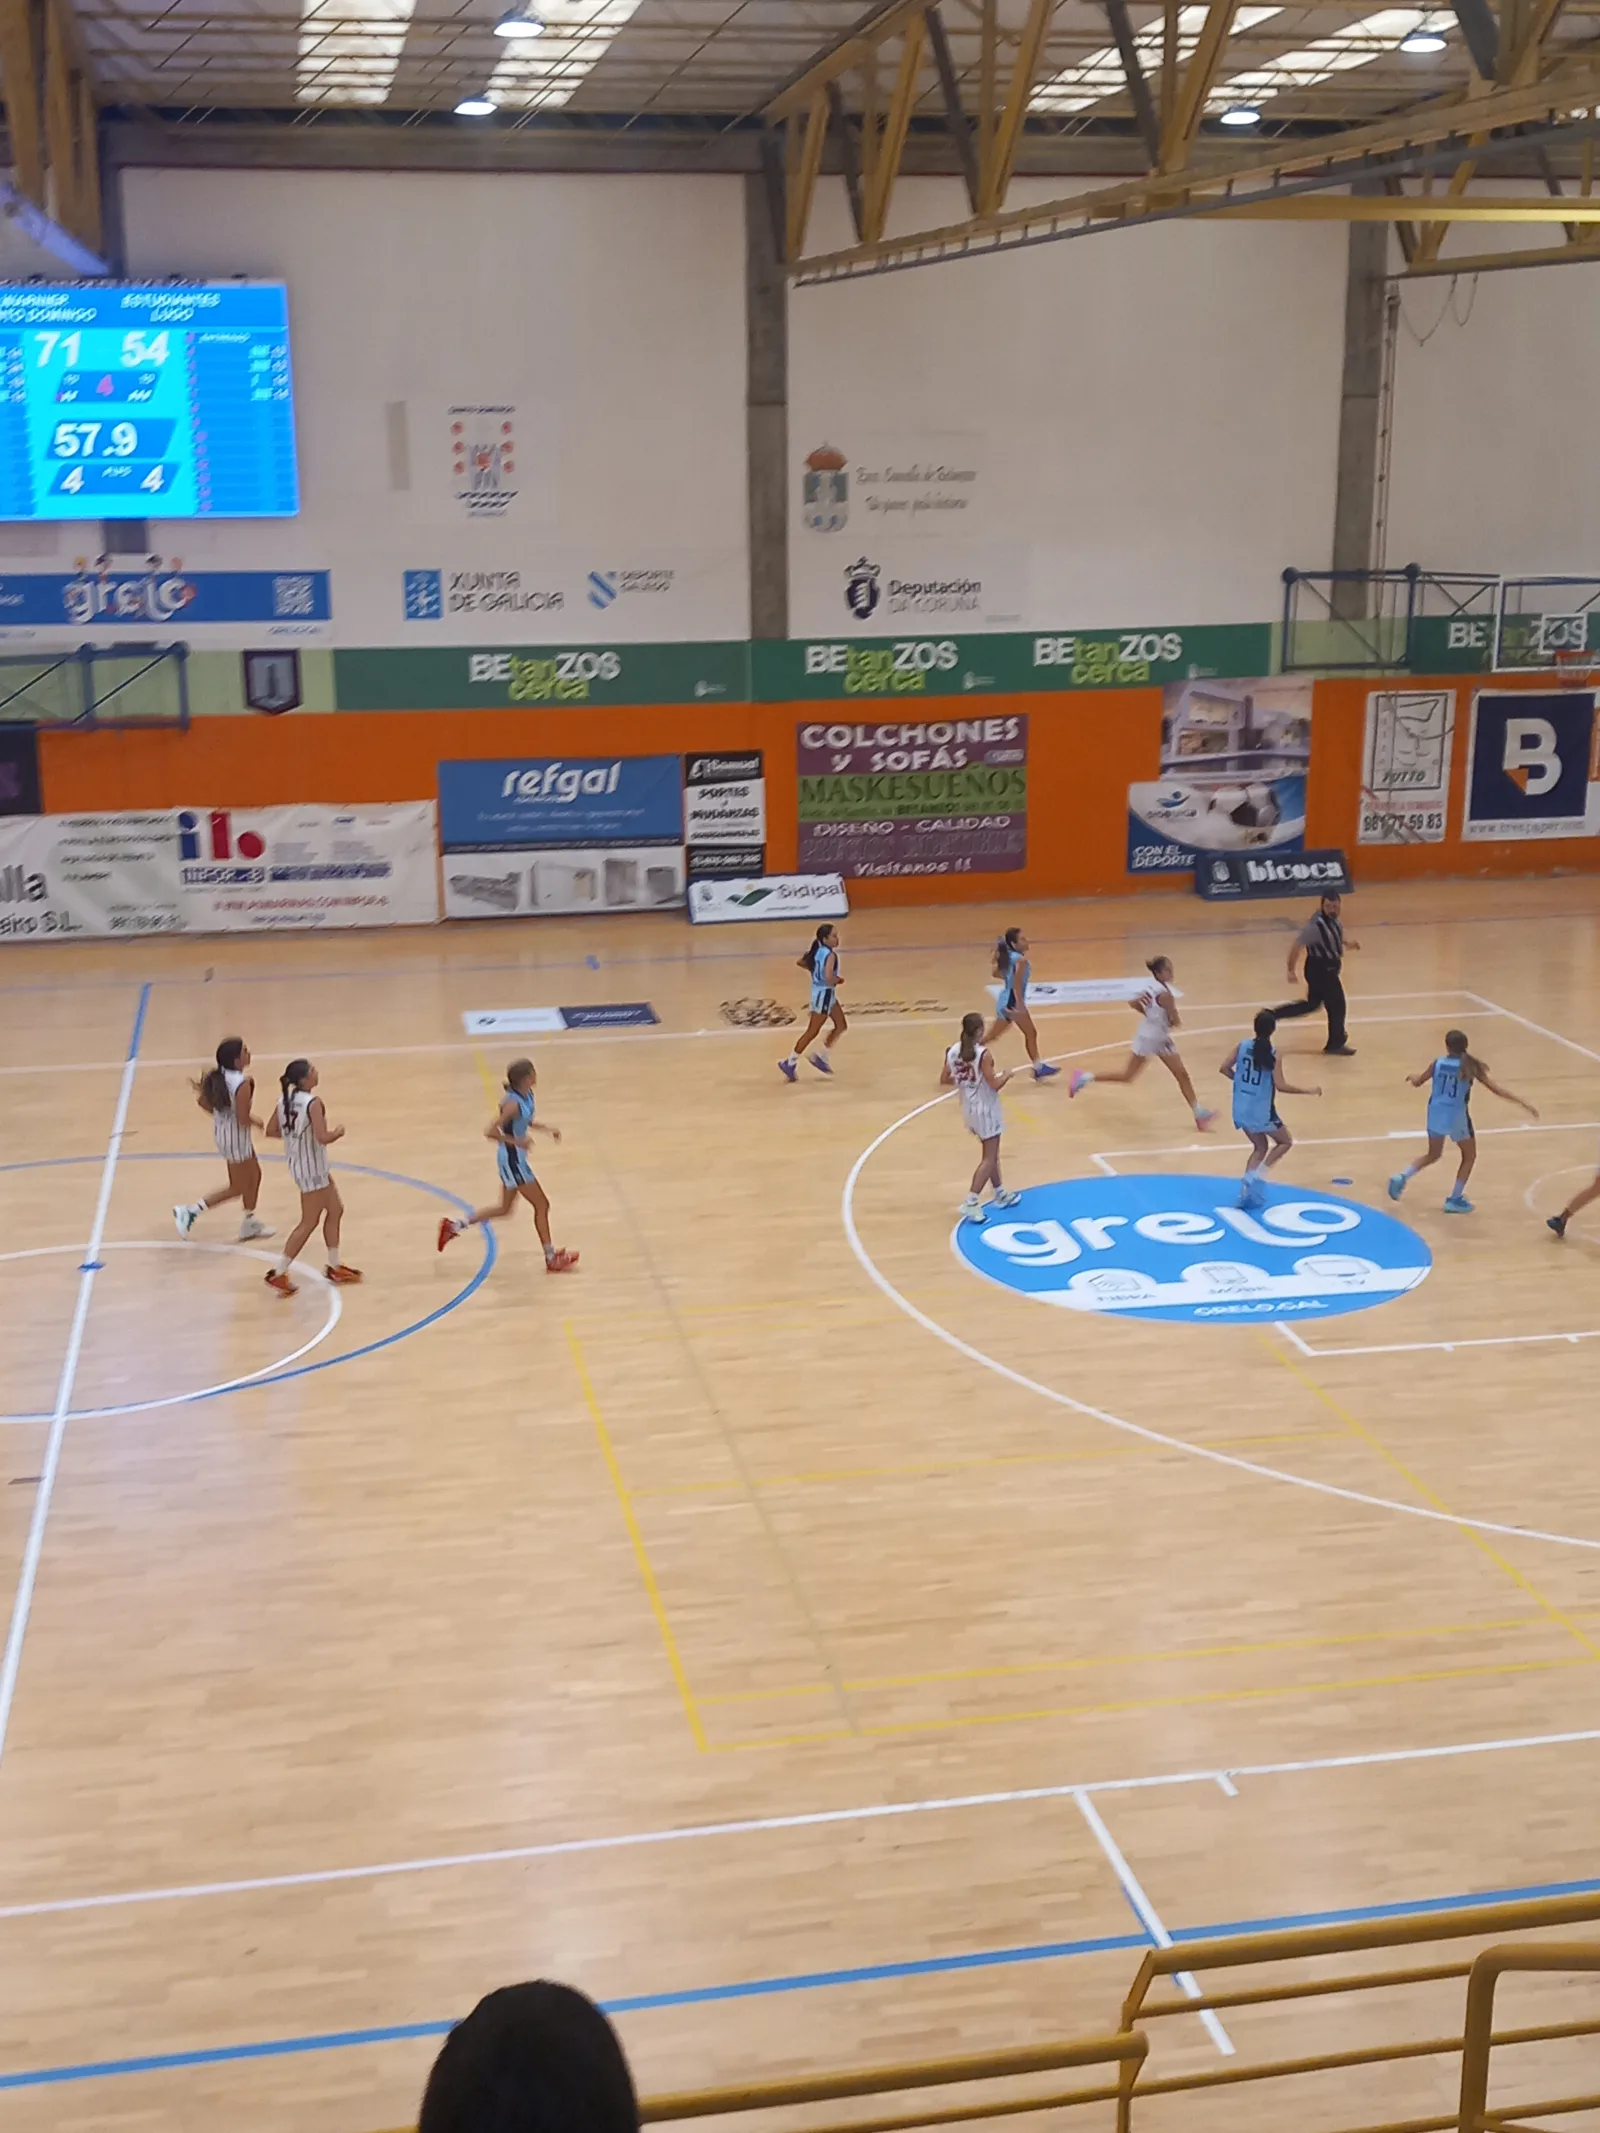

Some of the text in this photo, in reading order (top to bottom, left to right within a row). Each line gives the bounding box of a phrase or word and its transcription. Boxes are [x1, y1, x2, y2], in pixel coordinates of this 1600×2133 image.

[35, 331, 81, 367] 71
[120, 330, 169, 367] 54
[96, 373, 114, 397] 4
[53, 421, 138, 457] 57.9
[60, 465, 84, 494] 4
[140, 464, 164, 493] 4
[450, 572, 521, 591] XUNTA
[887, 579, 981, 598] Deputación
[450, 592, 564, 612] DE GALICIA
[843, 669, 926, 693] cerca
[1070, 660, 1150, 685] cerca
[801, 717, 1020, 749] COLCHONES
[870, 745, 968, 772] SOFÁS
[1503, 718, 1563, 795] B
[501, 761, 622, 804] refgal
[799, 764, 1027, 804] MASKESUEÑOS
[813, 821, 896, 837] DISEÑO
[914, 815, 1012, 833] CALIDAD
[1426, 812, 1443, 829] 83
[1132, 854, 1196, 869] DEPORTE
[1133, 845, 1182, 857] CON EL
[1246, 860, 1344, 882] bicoca
[1438, 1073, 1458, 1099] 73
[980, 1201, 1362, 1267] grelo
